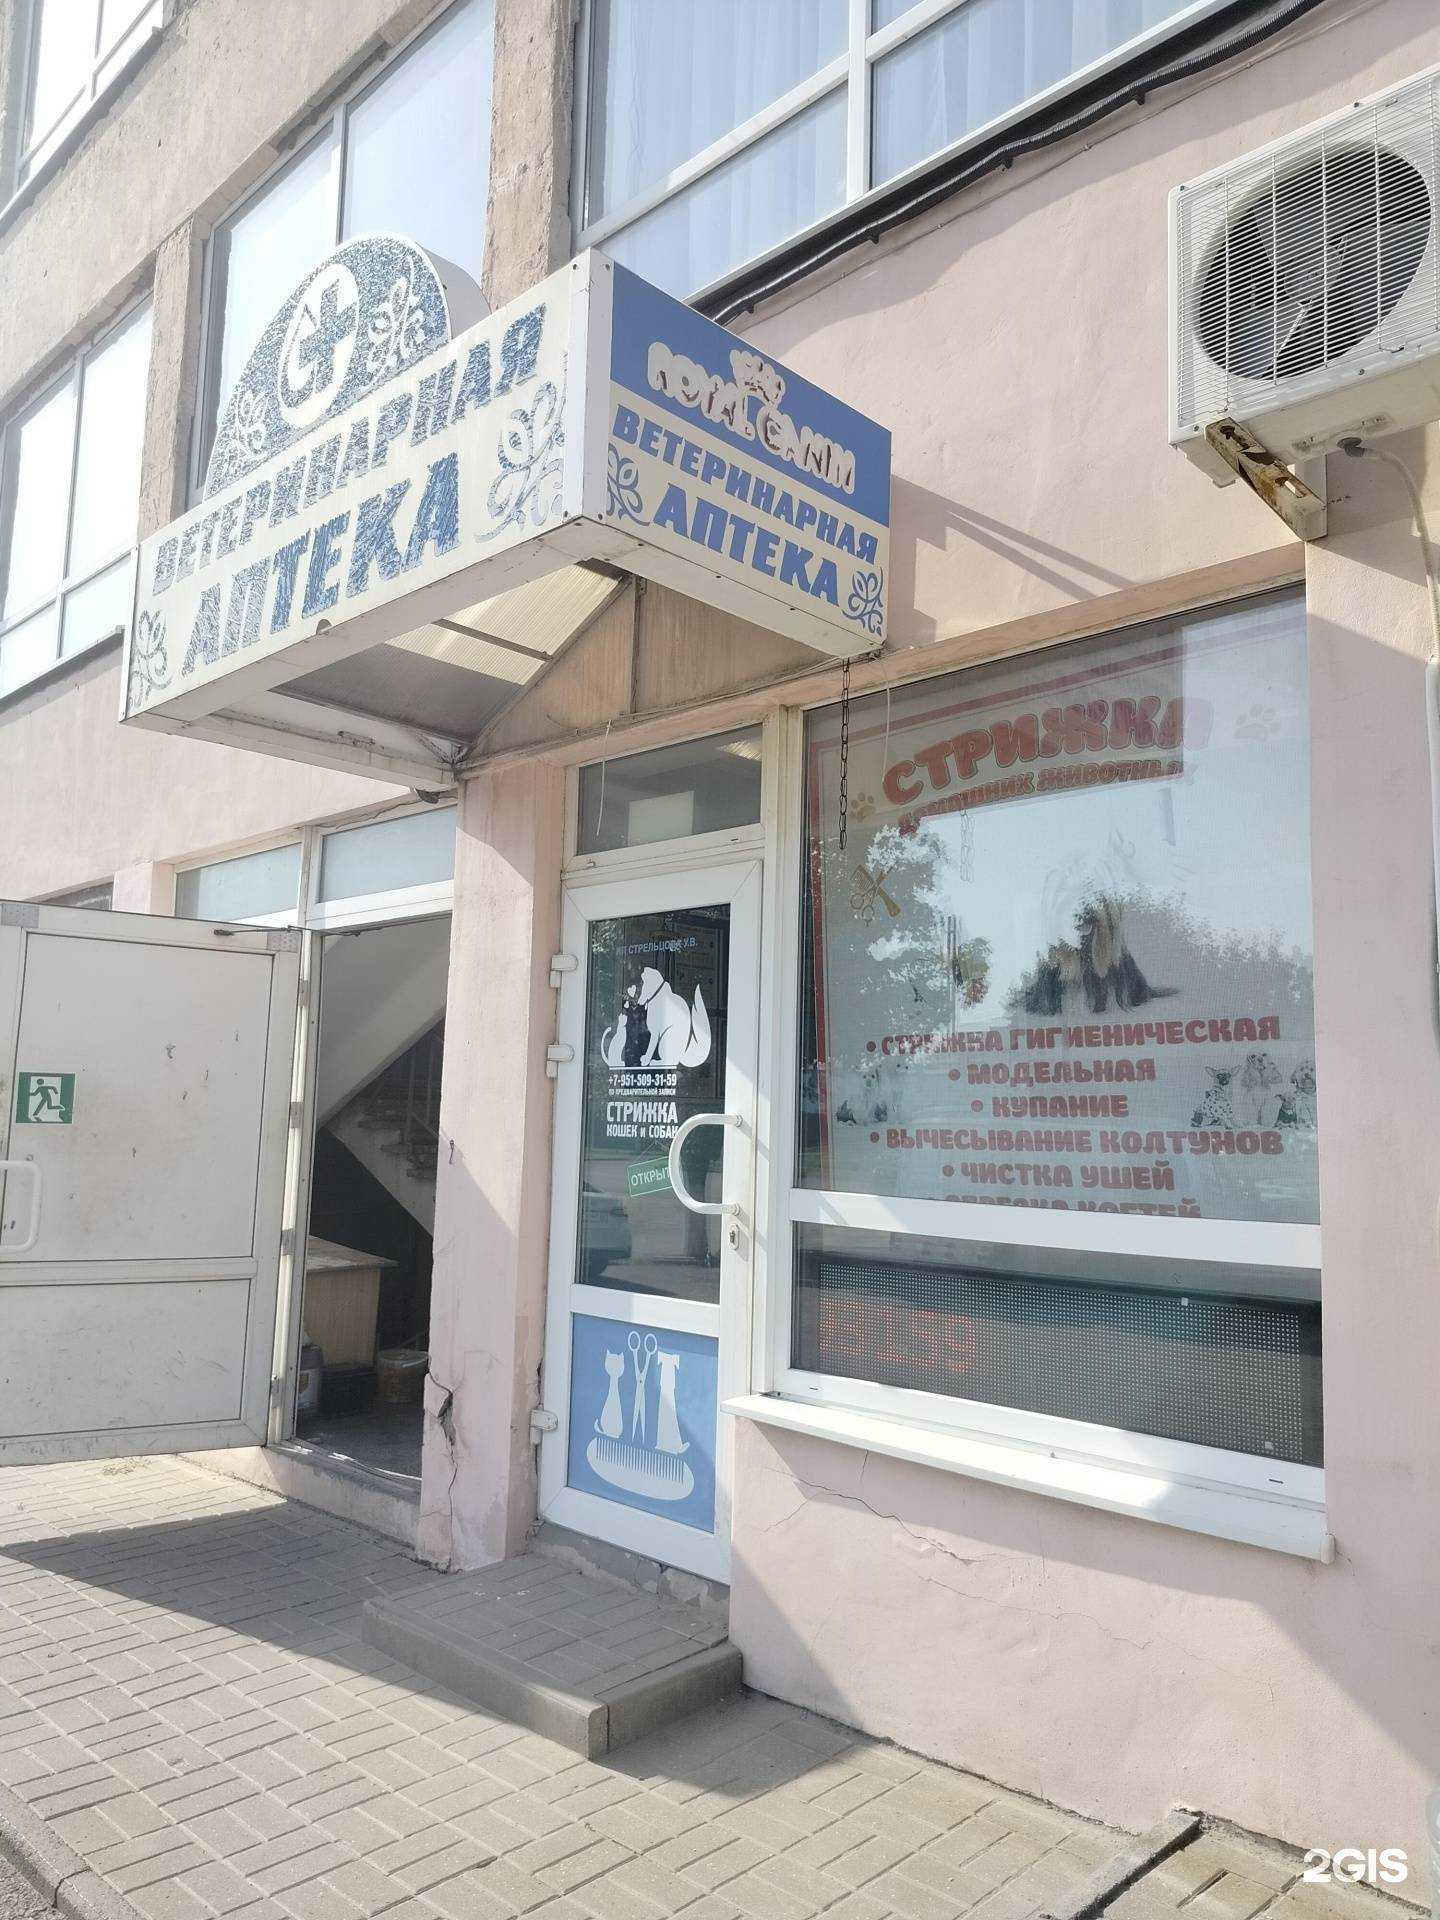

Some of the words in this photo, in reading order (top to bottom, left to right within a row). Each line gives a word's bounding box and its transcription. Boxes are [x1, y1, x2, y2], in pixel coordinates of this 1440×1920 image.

[152, 302, 547, 596] ВЕТЕРИНАРНАЯ
[612, 403, 879, 566] ВЕТЕРИНАРНАЯ
[652, 482, 840, 607] АПТЕКА
[181, 451, 461, 677] АПТЕКА
[1010, 1016, 1280, 1051] ГИГИЕНИЧЕСКАЯ
[967, 1058, 1156, 1088] МОДЕЛЬНАЯ
[606, 1101, 679, 1124] СТРИЖКА
[992, 1095, 1129, 1118] КУПАНИЕ
[606, 1124, 638, 1138] КОШЕК
[648, 1124, 679, 1139] СОБАК
[886, 1129, 1092, 1153] ВЫЧЕСЫВАНИЕ
[1099, 1131, 1284, 1155] КОЛТУНОВ
[961, 1161, 1074, 1188] ЧИСТКА
[1080, 1160, 1175, 1191] УШЕЙ
